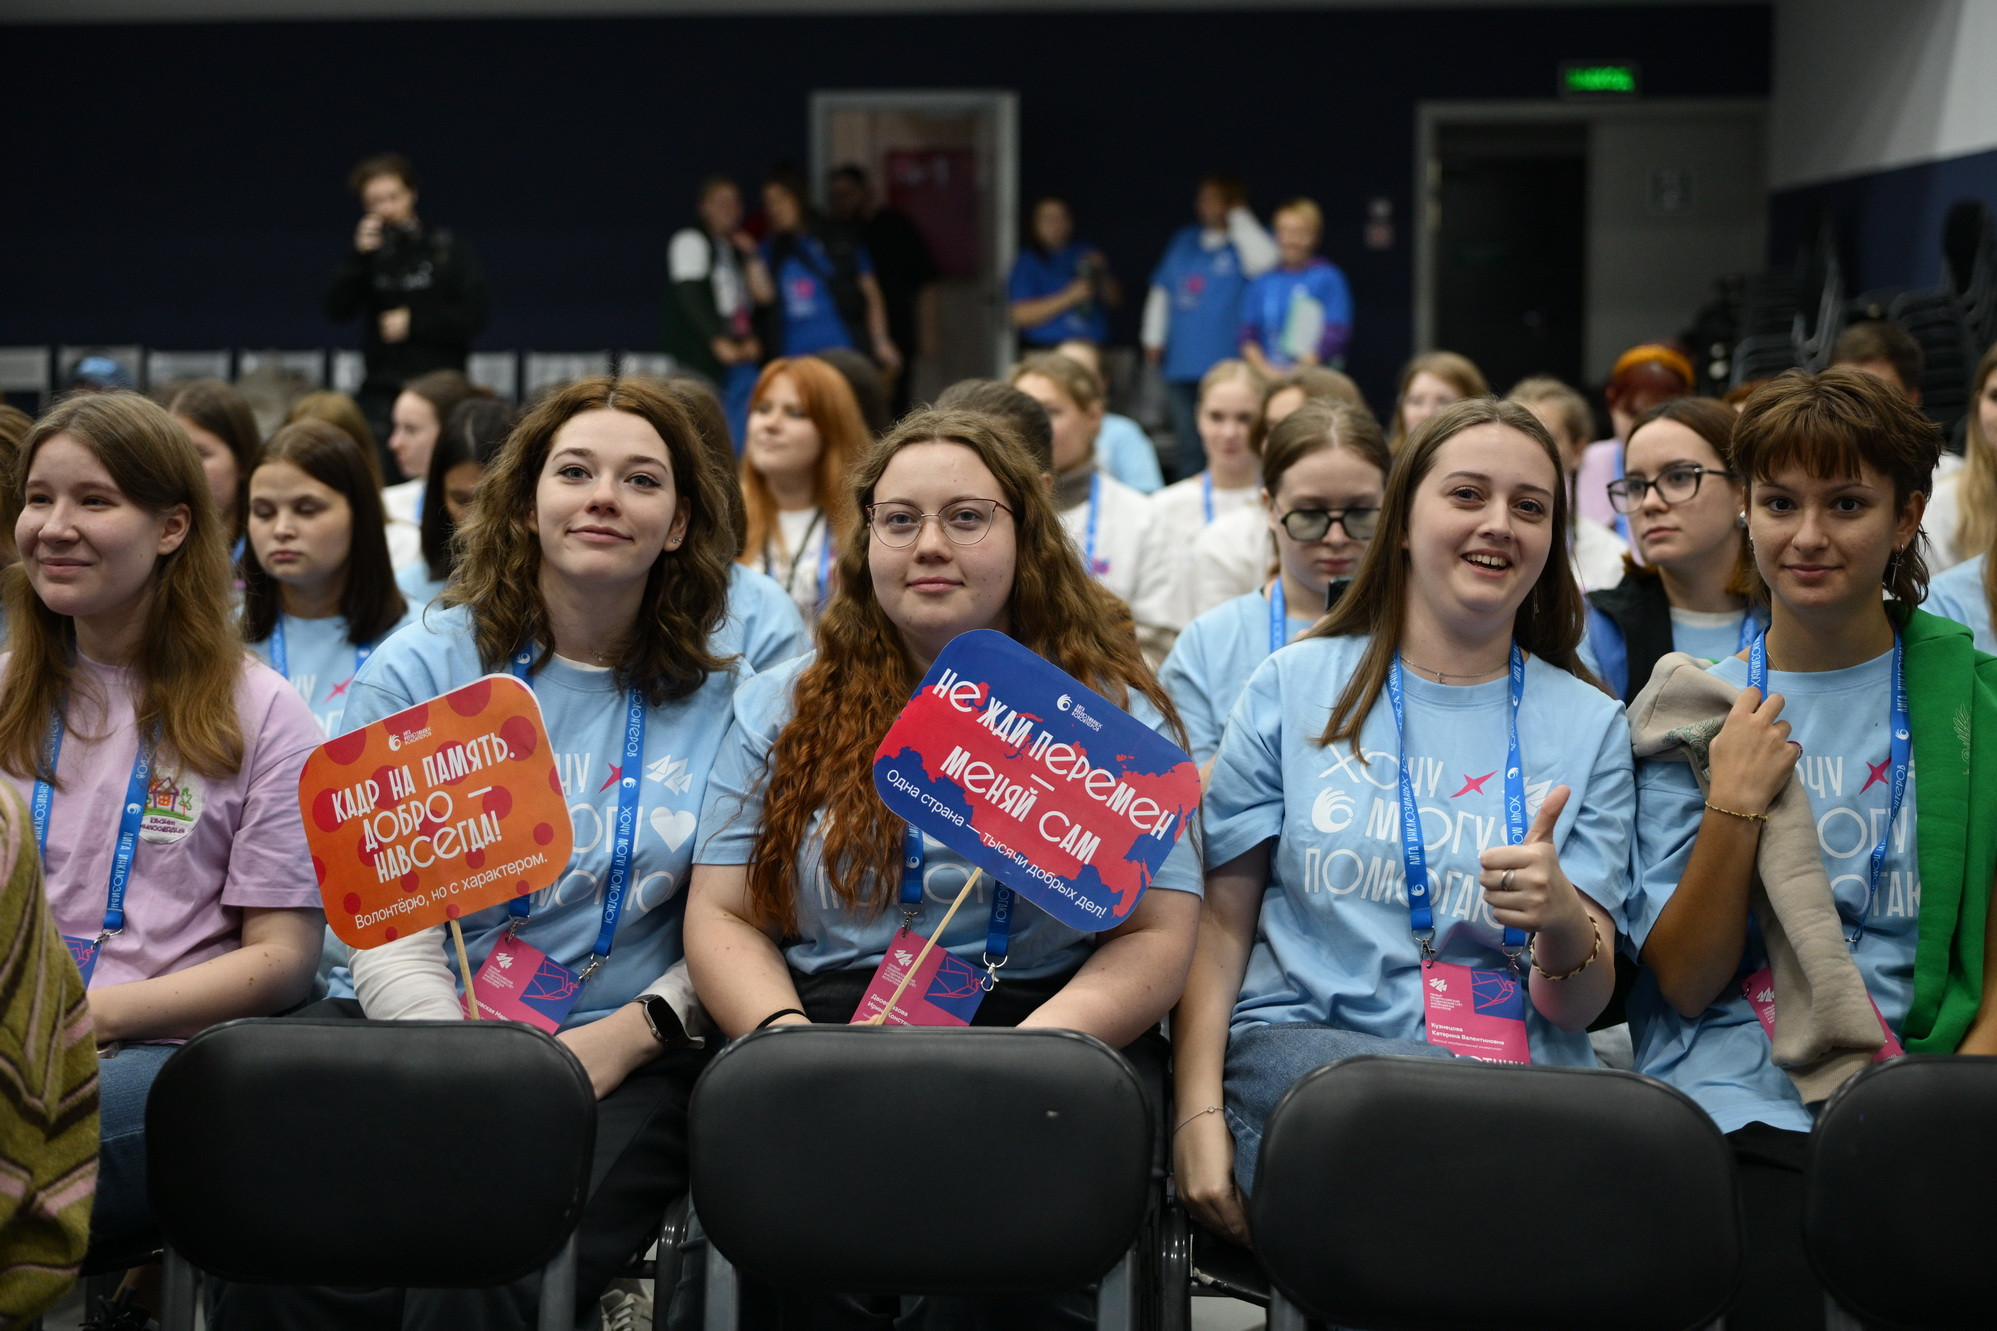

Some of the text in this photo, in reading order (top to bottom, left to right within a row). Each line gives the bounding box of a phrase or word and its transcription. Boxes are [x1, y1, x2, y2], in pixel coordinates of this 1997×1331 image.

[976, 697, 1033, 748] ЖДИ
[331, 779, 380, 823] КАДР
[388, 765, 416, 801] НА
[422, 732, 515, 788] ПАМЯТЬ.
[554, 752, 591, 796] ЧУ
[1795, 756, 1843, 798] ЧУ
[362, 791, 453, 852] ДОБРО
[1509, 794, 1522, 824] ХОЧУ!
[1817, 806, 1908, 859] ОГУ
[887, 769, 920, 799] Одна
[921, 793, 964, 828] страна
[983, 831, 1029, 868] тысячи
[1026, 863, 1075, 901] добрых
[1076, 895, 1107, 919] дел!
[1038, 810, 1101, 864] САМ
[1409, 845, 1421, 865] ЛИГА
[107, 831, 134, 911] ЛИГА ИНКЛЮЗИВН
[354, 852, 548, 929] Волонтёрю, но с характером.
[604, 805, 633, 924] ХОЧУ! МОГУ! ПОМОГАЮ!
